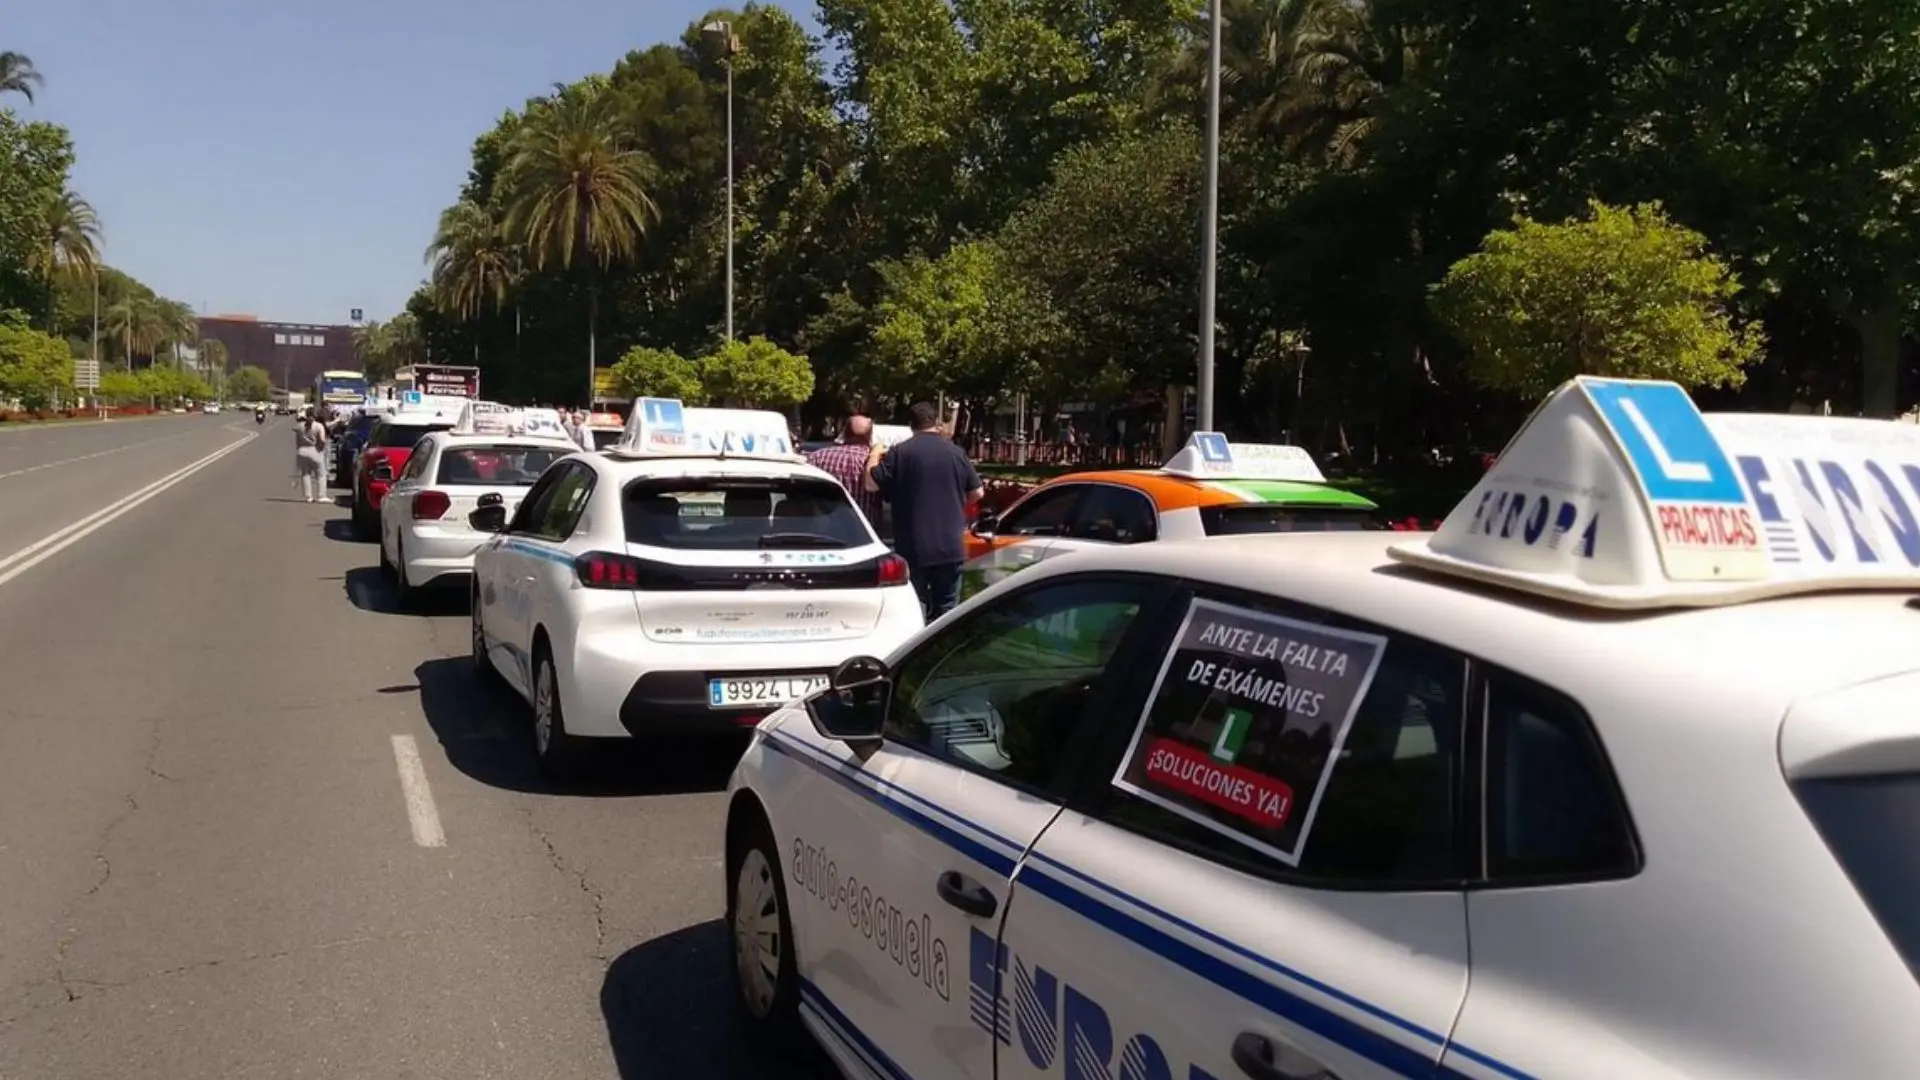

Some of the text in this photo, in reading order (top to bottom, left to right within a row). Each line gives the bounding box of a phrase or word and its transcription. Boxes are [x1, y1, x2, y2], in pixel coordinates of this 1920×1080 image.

[1203, 438, 1224, 459] L
[1618, 398, 1713, 482] L
[1466, 491, 1599, 557] EUROPA
[1658, 505, 1758, 547] PRACTICAS
[1199, 621, 1350, 677] ANTE LA FALTA
[727, 677, 827, 700] 9924 LZ
[1187, 659, 1326, 718] DE EXÁMENES
[1213, 713, 1236, 762] L
[1147, 749, 1289, 818] ¡SOLUCIONES YA!
[792, 837, 951, 1003] auto-escuela
[970, 925, 1220, 1080] EUR
